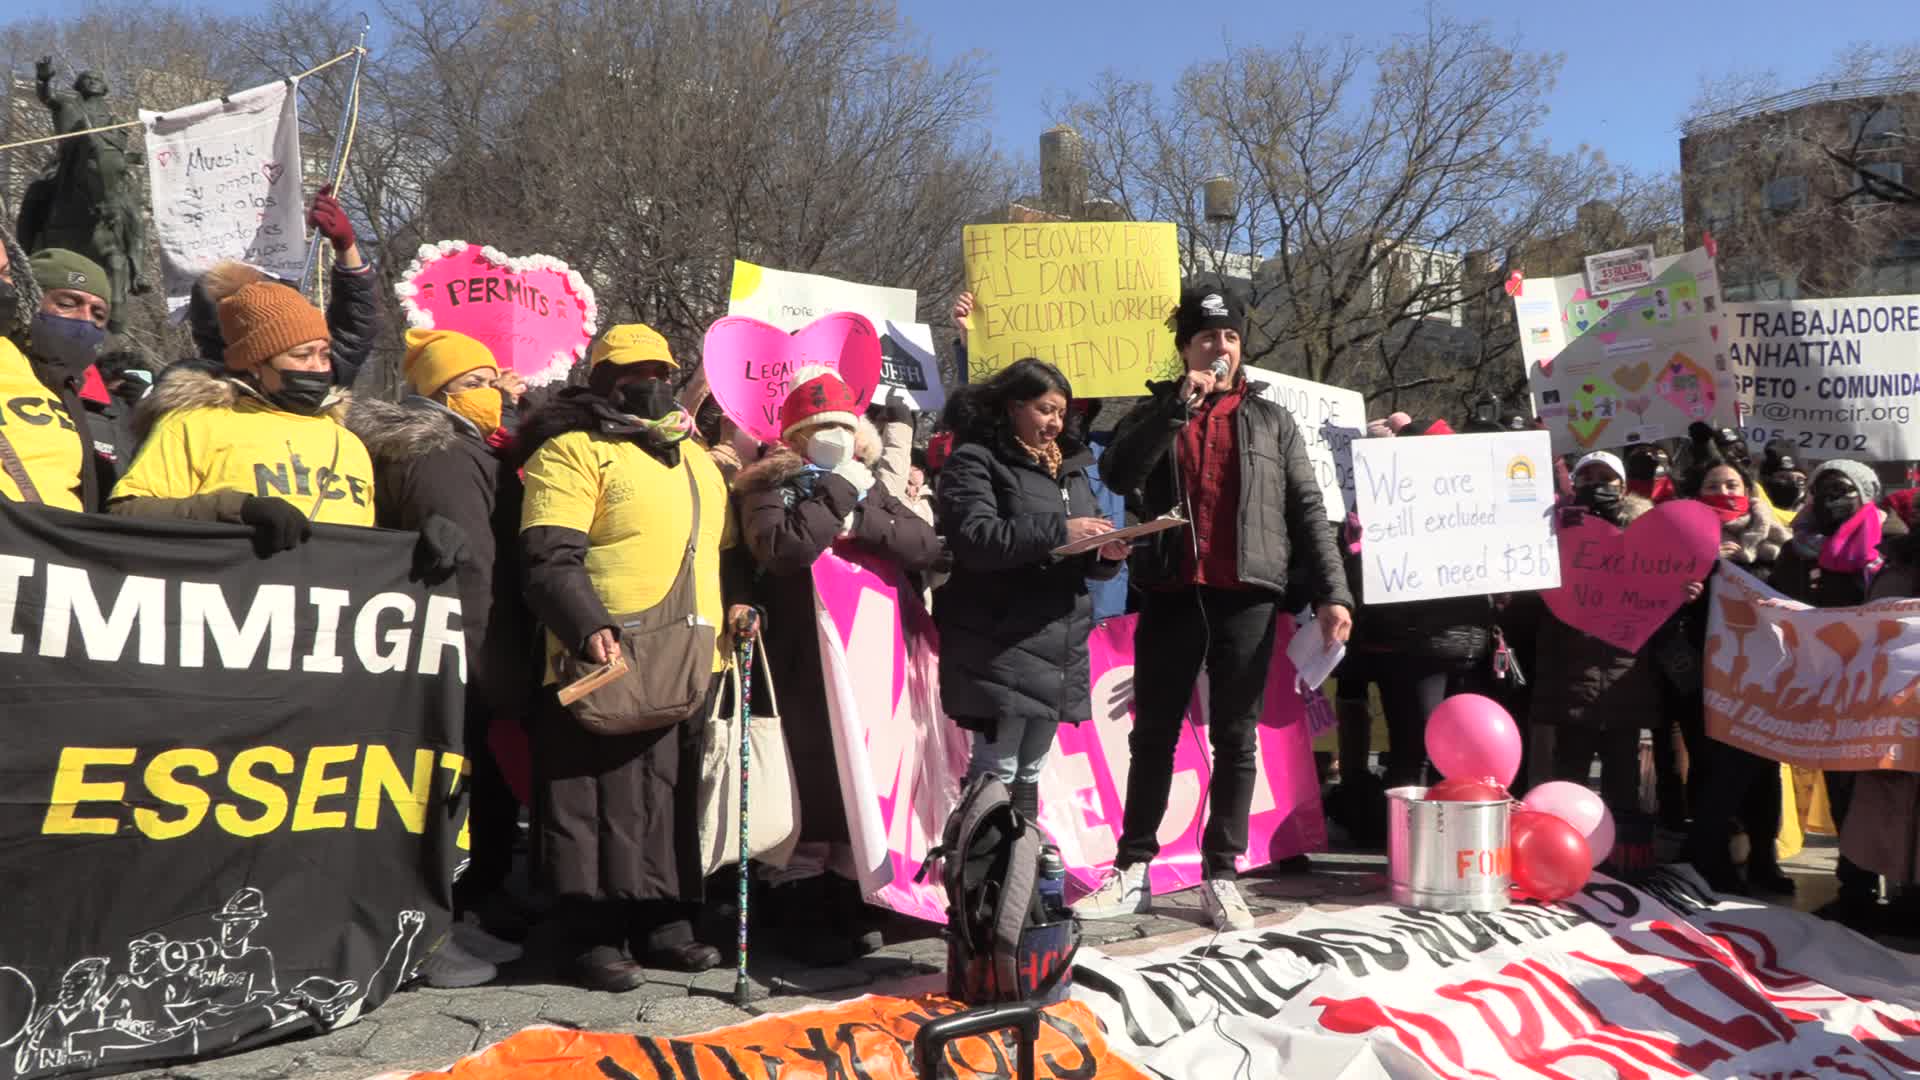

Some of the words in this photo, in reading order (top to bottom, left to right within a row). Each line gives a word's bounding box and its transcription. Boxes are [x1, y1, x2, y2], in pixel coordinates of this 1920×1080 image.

[968, 231, 992, 262] #
[1003, 223, 1116, 264] RECOVERY
[1124, 225, 1161, 257] FOR
[447, 276, 549, 317] PERMITS
[970, 263, 1031, 298] ALL
[1115, 257, 1168, 292] LEAVE
[782, 304, 815, 319] more
[984, 302, 1086, 339] EXCLUDED
[1736, 306, 1920, 338] TRABAJADORE
[253, 448, 368, 507] NICE
[1356, 451, 1416, 505] We
[1433, 472, 1475, 495] are
[1367, 506, 1415, 542] still
[1424, 503, 1497, 533] excluded
[1376, 551, 1423, 593] We
[1436, 545, 1488, 587] need
[1573, 541, 1698, 577] Excluded
[1743, 705, 1834, 742] Domestic
